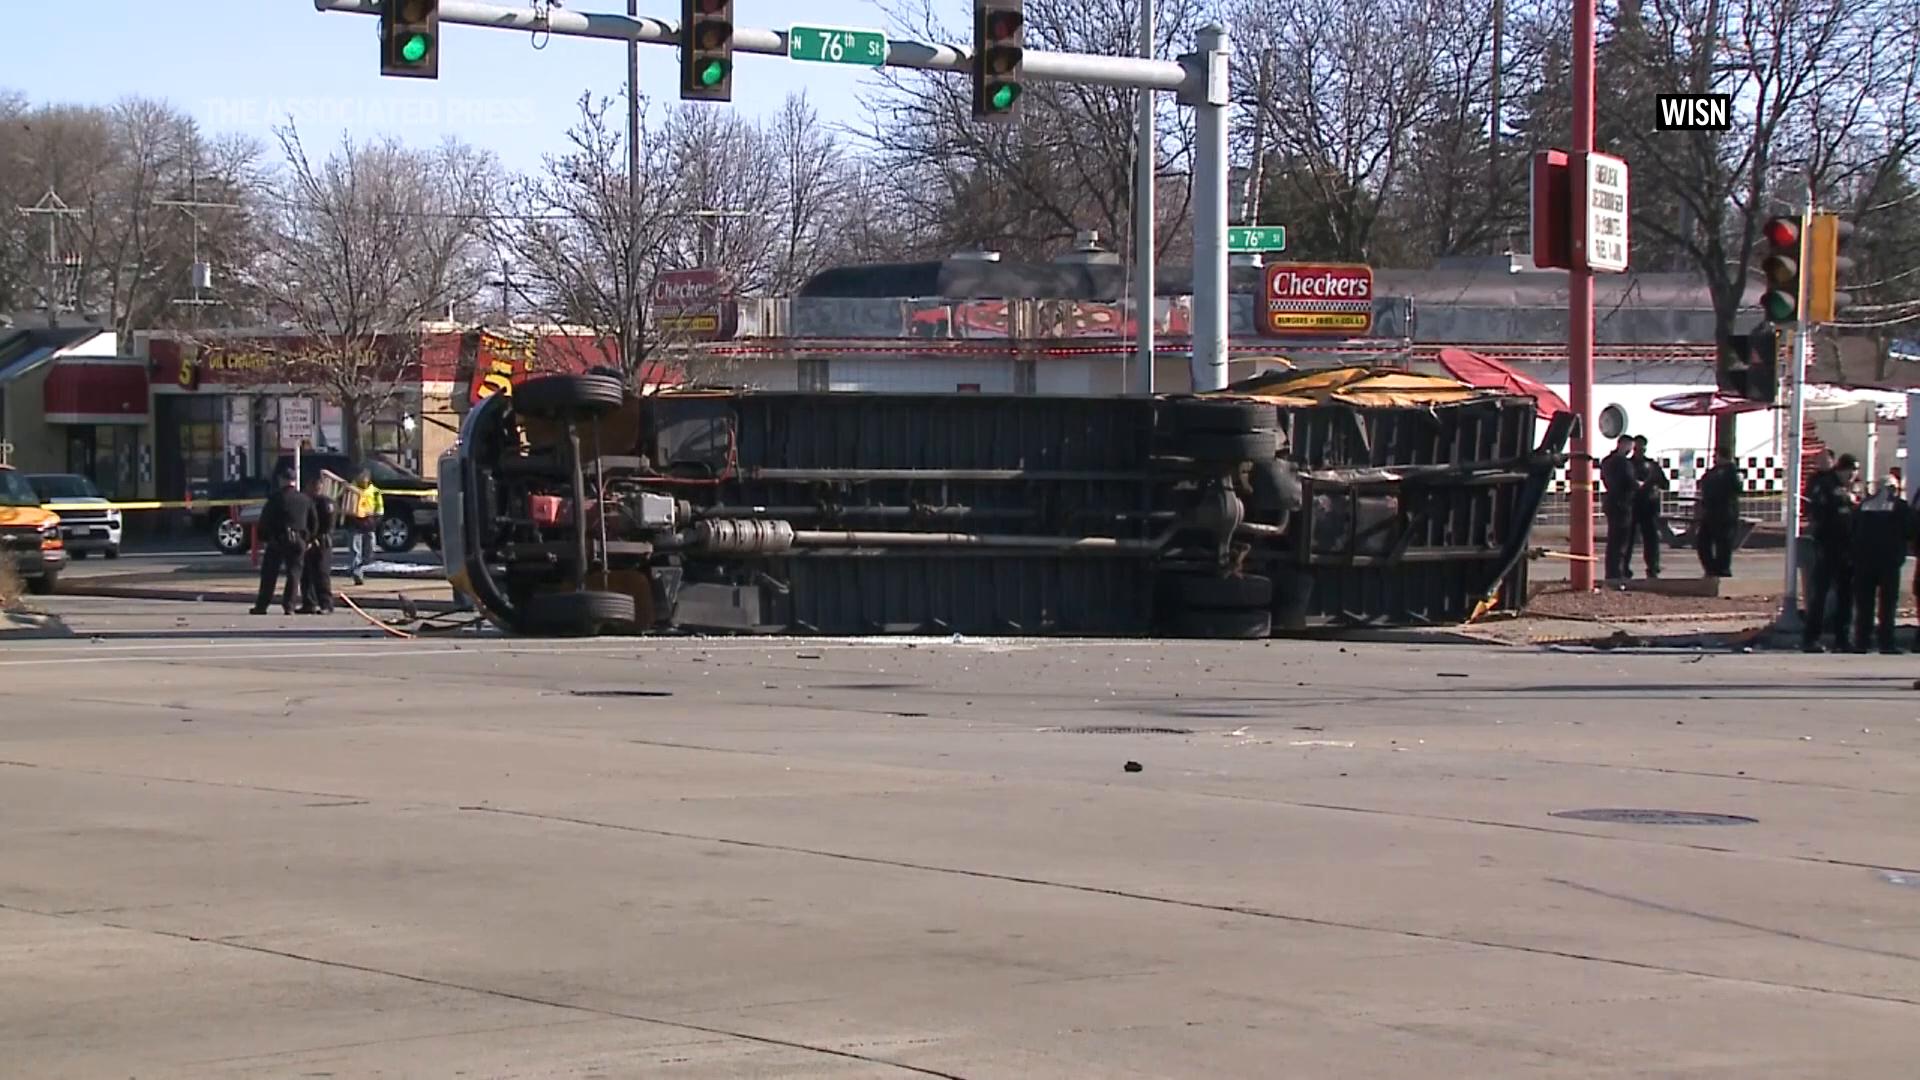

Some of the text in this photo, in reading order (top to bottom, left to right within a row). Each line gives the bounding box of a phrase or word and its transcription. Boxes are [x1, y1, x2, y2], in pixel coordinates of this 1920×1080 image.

[794, 32, 880, 61] N 76th St
[1229, 234, 1235, 243] N
[1272, 271, 1369, 298] Checkers
[178, 358, 193, 386] 5
